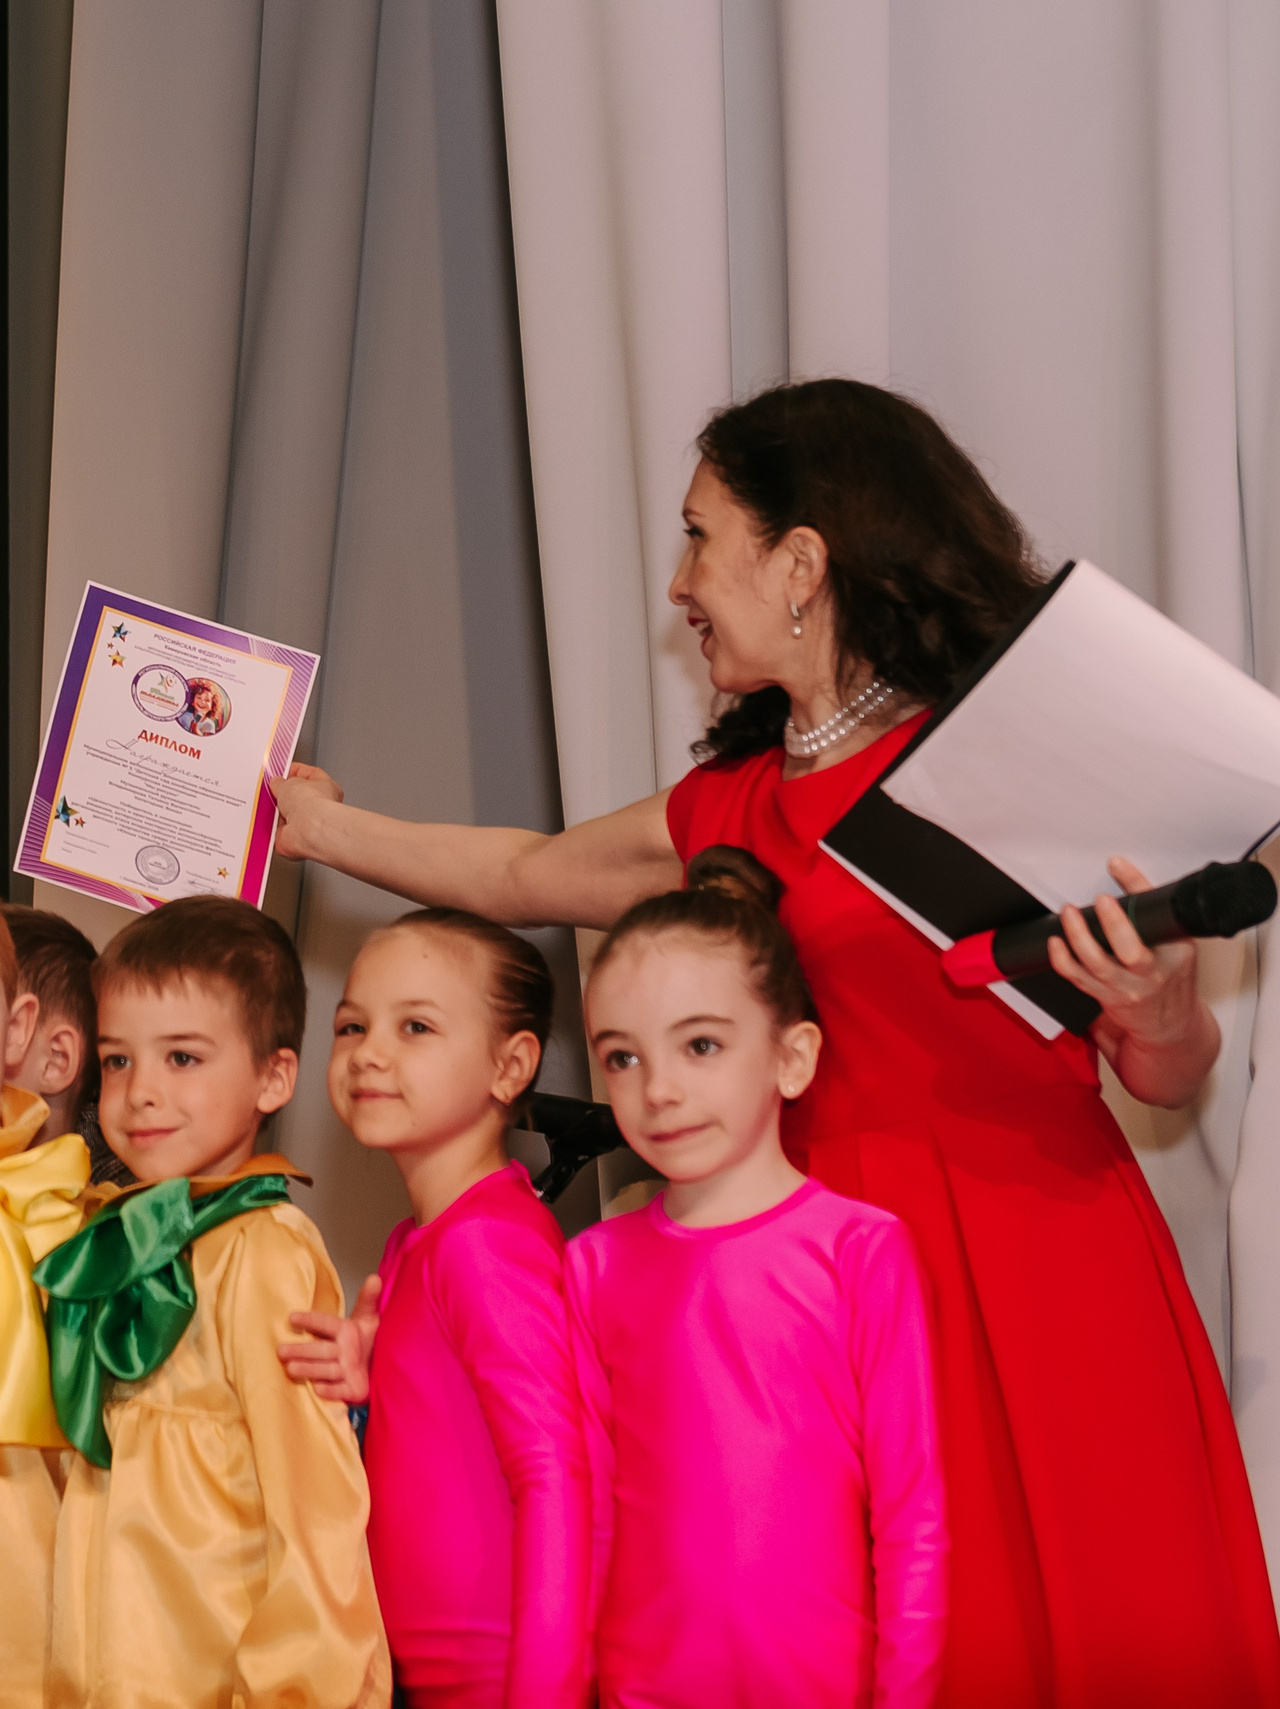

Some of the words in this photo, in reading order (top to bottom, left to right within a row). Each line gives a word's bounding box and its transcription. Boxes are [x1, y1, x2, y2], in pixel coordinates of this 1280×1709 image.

[153, 633, 197, 652] РОССИЙСКАЯ
[196, 648, 236, 665] ФЕДЕРАЦИЯ
[137, 729, 201, 760] ДИПЛОМ
[106, 738, 221, 787] Награждается
